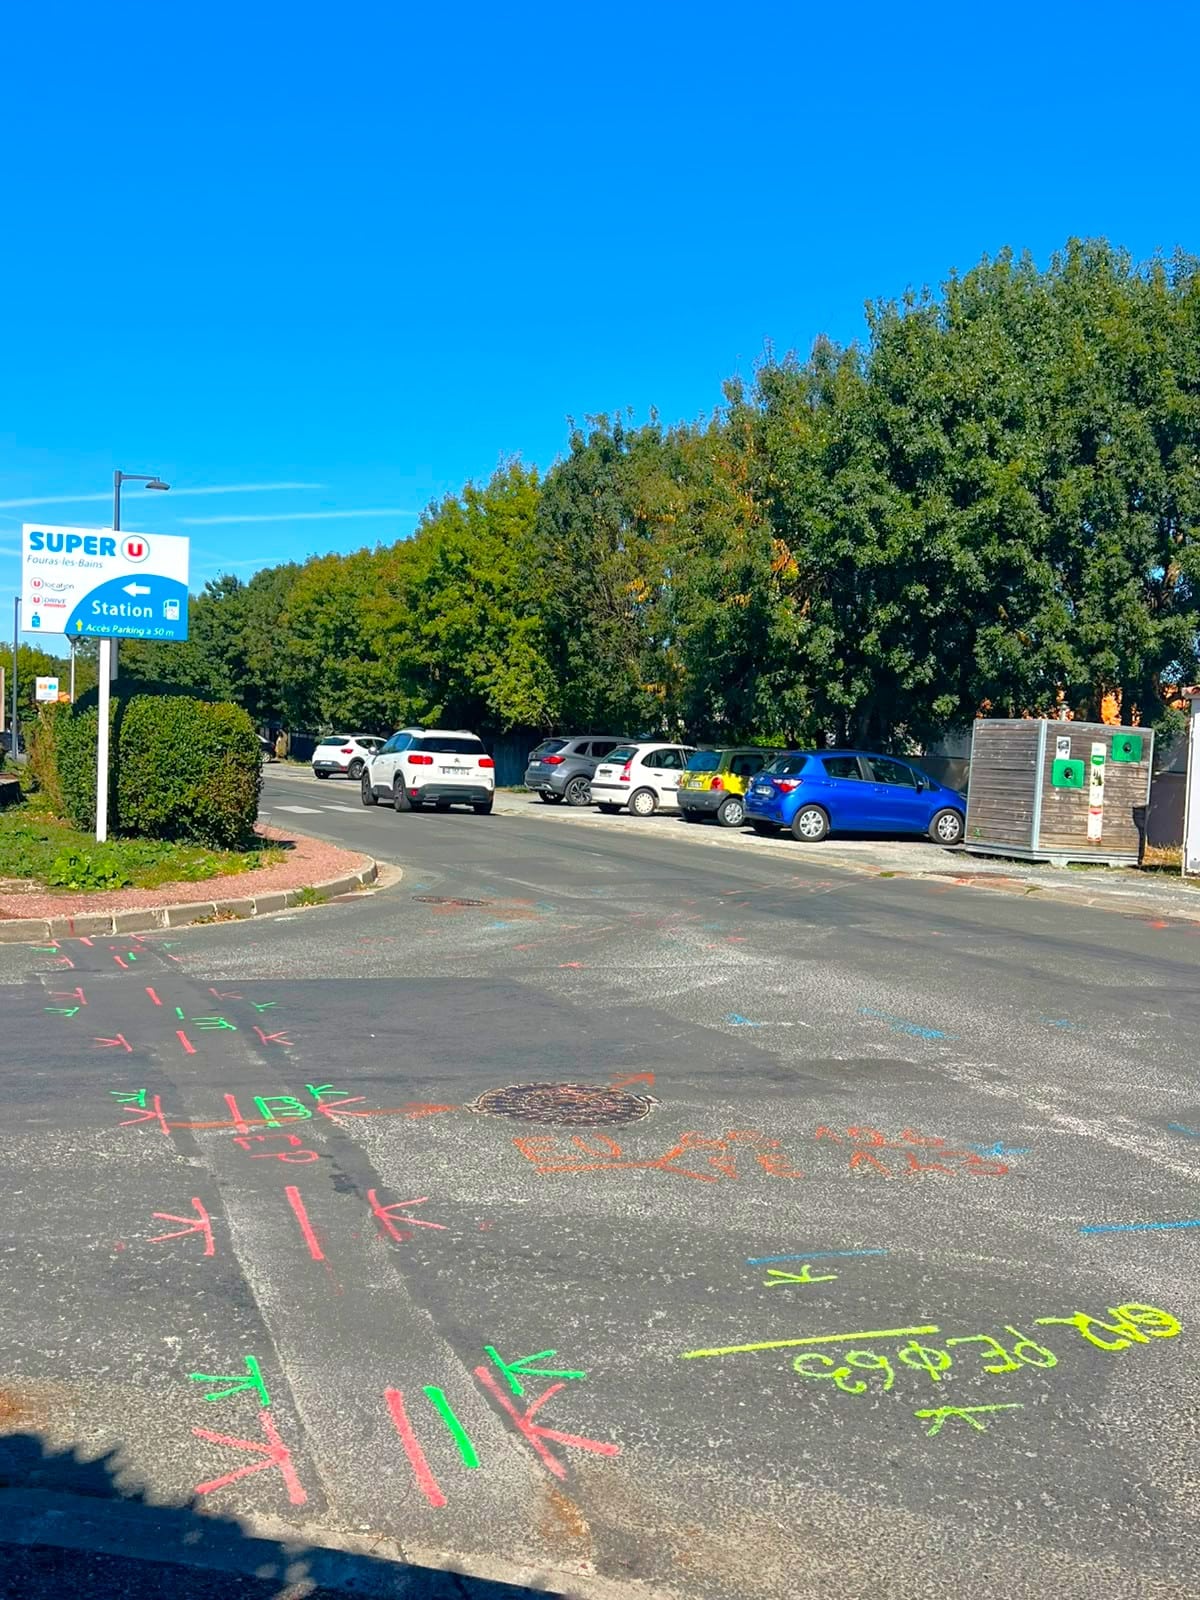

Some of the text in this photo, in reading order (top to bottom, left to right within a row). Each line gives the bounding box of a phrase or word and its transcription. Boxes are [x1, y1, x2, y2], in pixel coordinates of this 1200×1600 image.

[29, 531, 116, 556] SUPER
[92, 600, 153, 618] Station
[86, 623, 110, 632] Accès
[112, 625, 144, 636] Parking
[153, 627, 164, 635] 50
